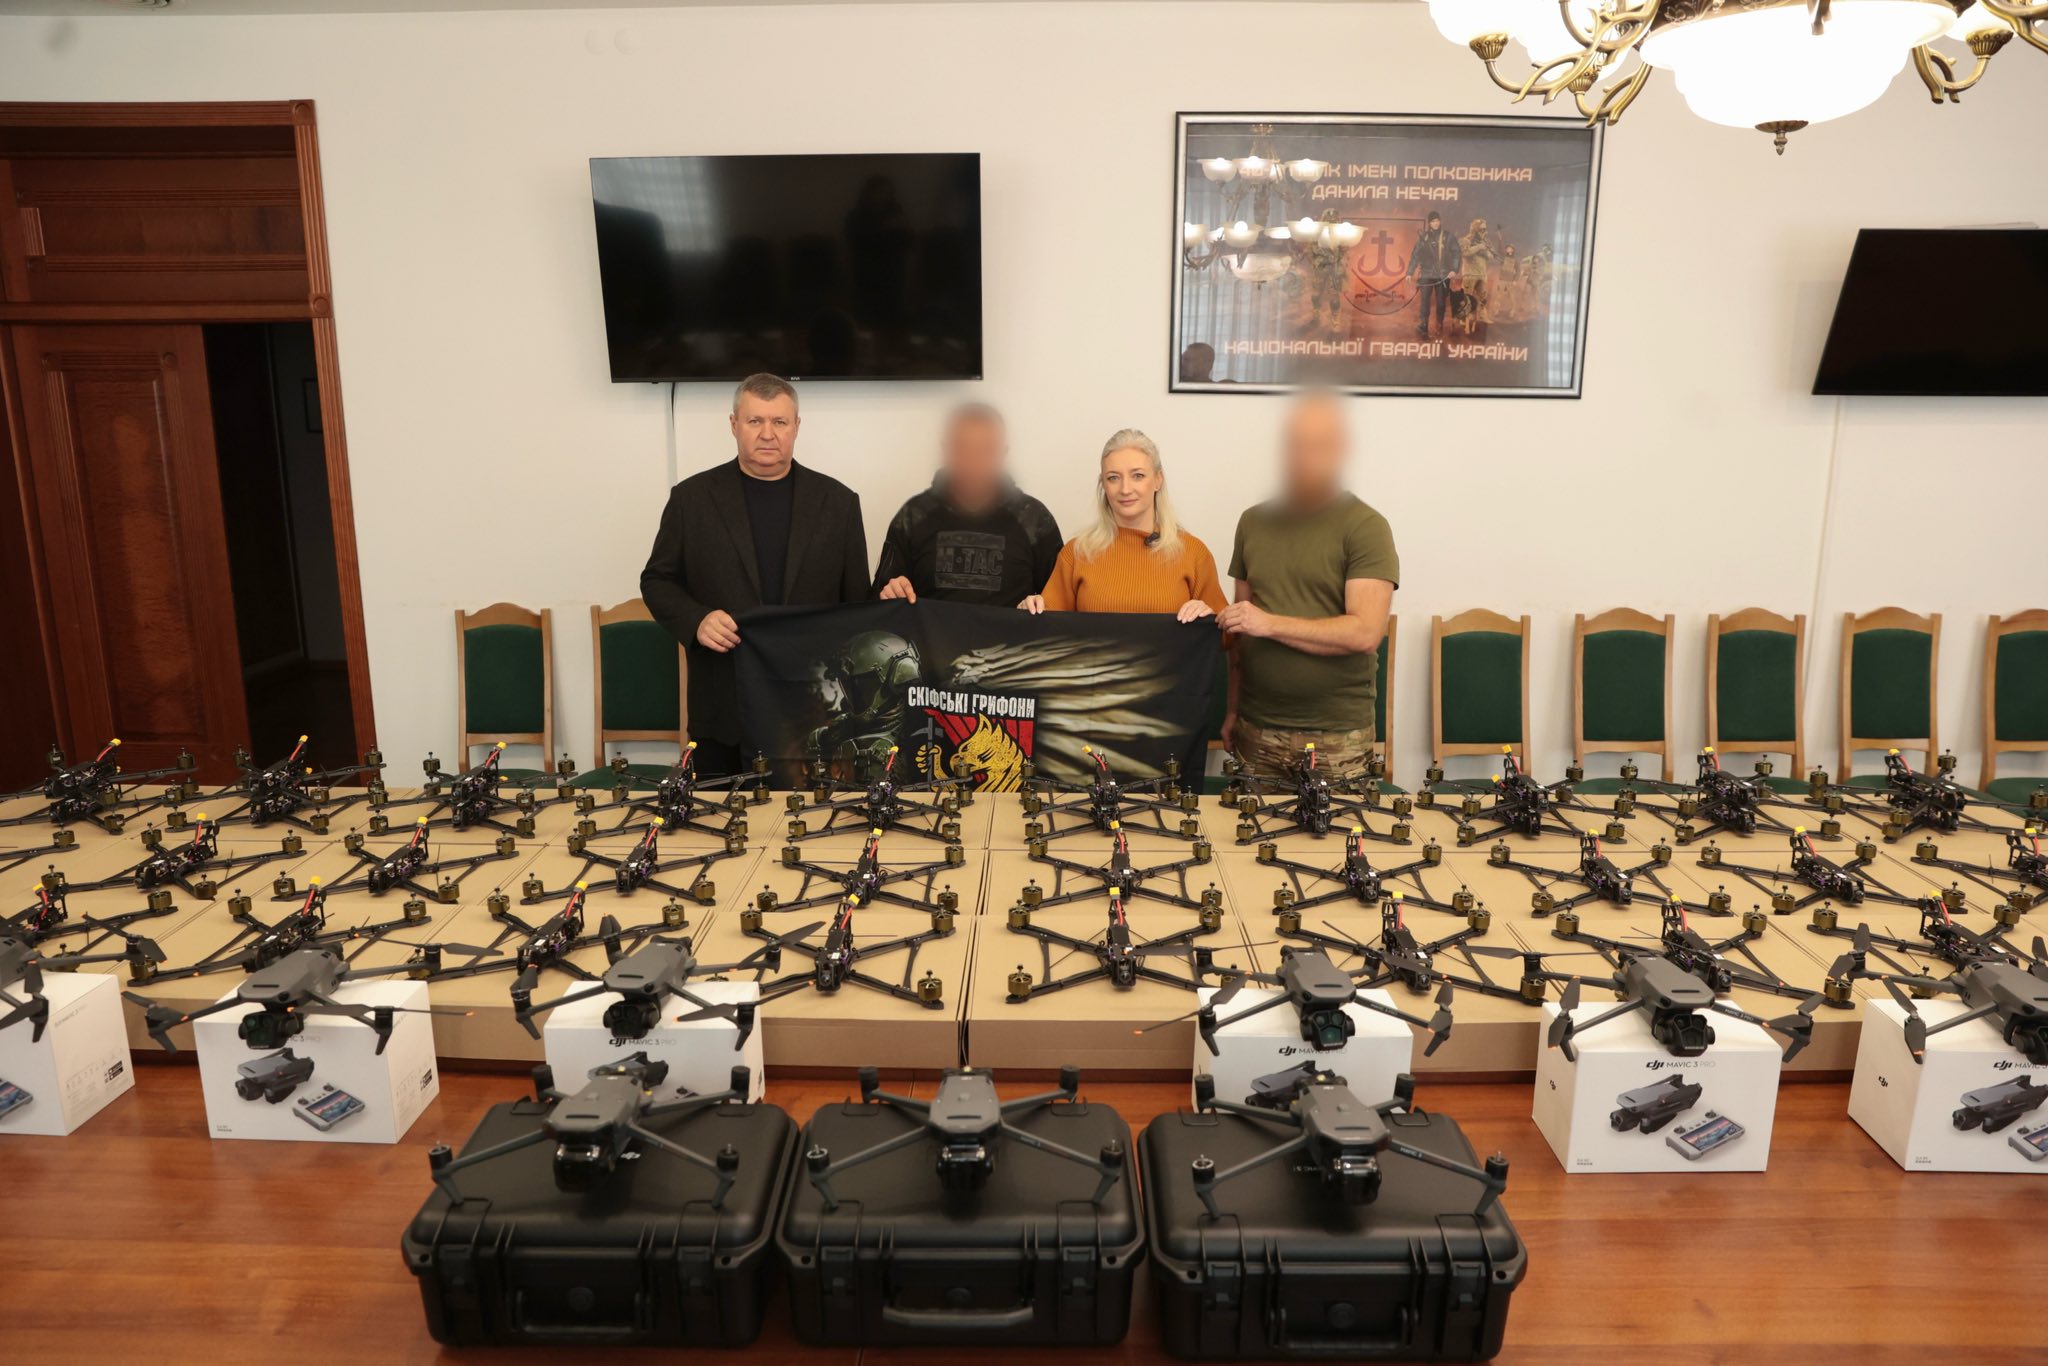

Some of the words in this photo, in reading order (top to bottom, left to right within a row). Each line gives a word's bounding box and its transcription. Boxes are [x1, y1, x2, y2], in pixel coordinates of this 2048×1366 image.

[1348, 164, 1397, 178] ІМЕНІ
[1404, 165, 1533, 182] ПОЛКОВНИКА
[1312, 184, 1389, 200] ДАНИЛА
[1396, 186, 1459, 201] НЕЧАЯ
[1224, 338, 1365, 357] НАЦІОНАЛЬНОЇ
[1370, 339, 1443, 360] ГВАРДІЇ
[1447, 342, 1529, 361] УКРАЇНИ
[908, 686, 969, 714] СКІФСЬКІ
[972, 693, 1035, 718] ГРИФОНИ
